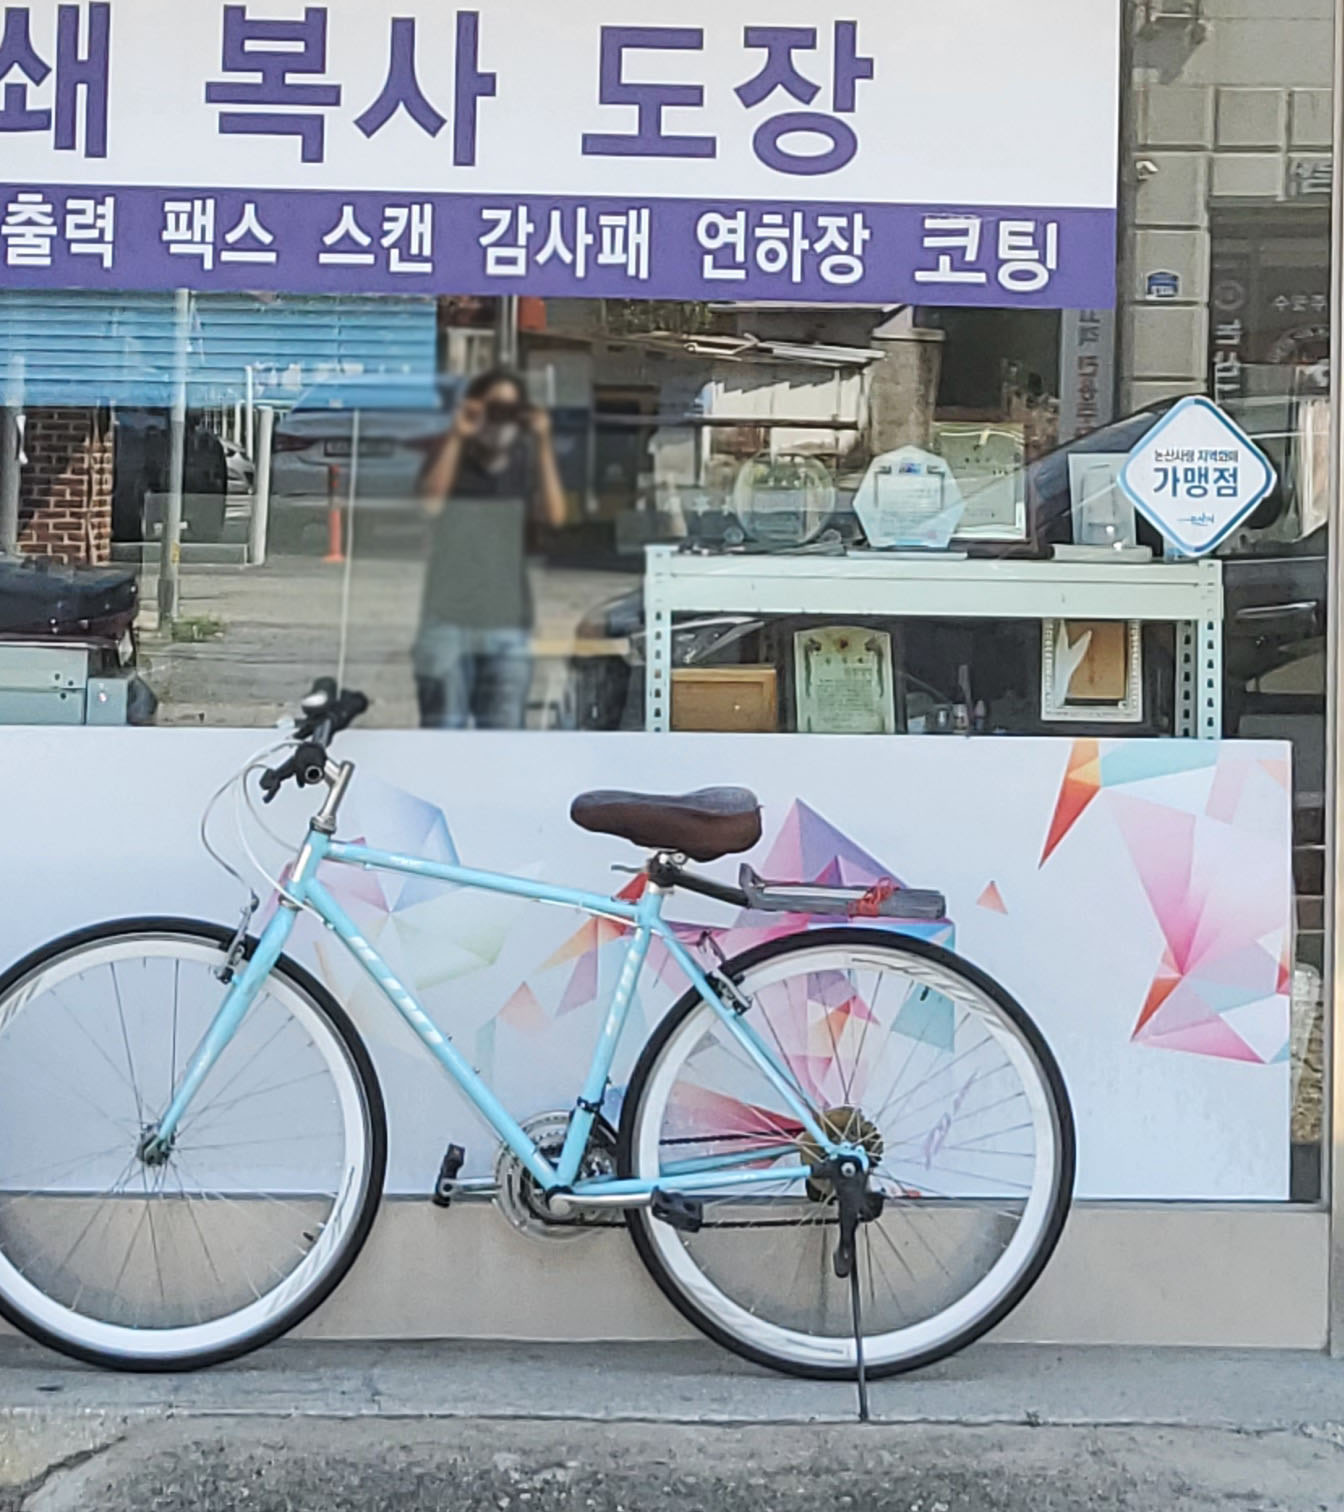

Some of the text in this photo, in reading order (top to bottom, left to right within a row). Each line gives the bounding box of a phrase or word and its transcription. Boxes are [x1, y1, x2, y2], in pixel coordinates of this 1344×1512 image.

[204, 3, 497, 166] 복사
[581, 19, 874, 176] 도장
[0, 193, 116, 270] 출력
[161, 198, 277, 270] 팩스
[318, 202, 435, 273] 스캔
[478, 205, 650, 279] 감사패
[695, 209, 870, 284] 연하장
[914, 217, 1059, 292] 코팅
[1153, 465, 1238, 498] 가맹점
